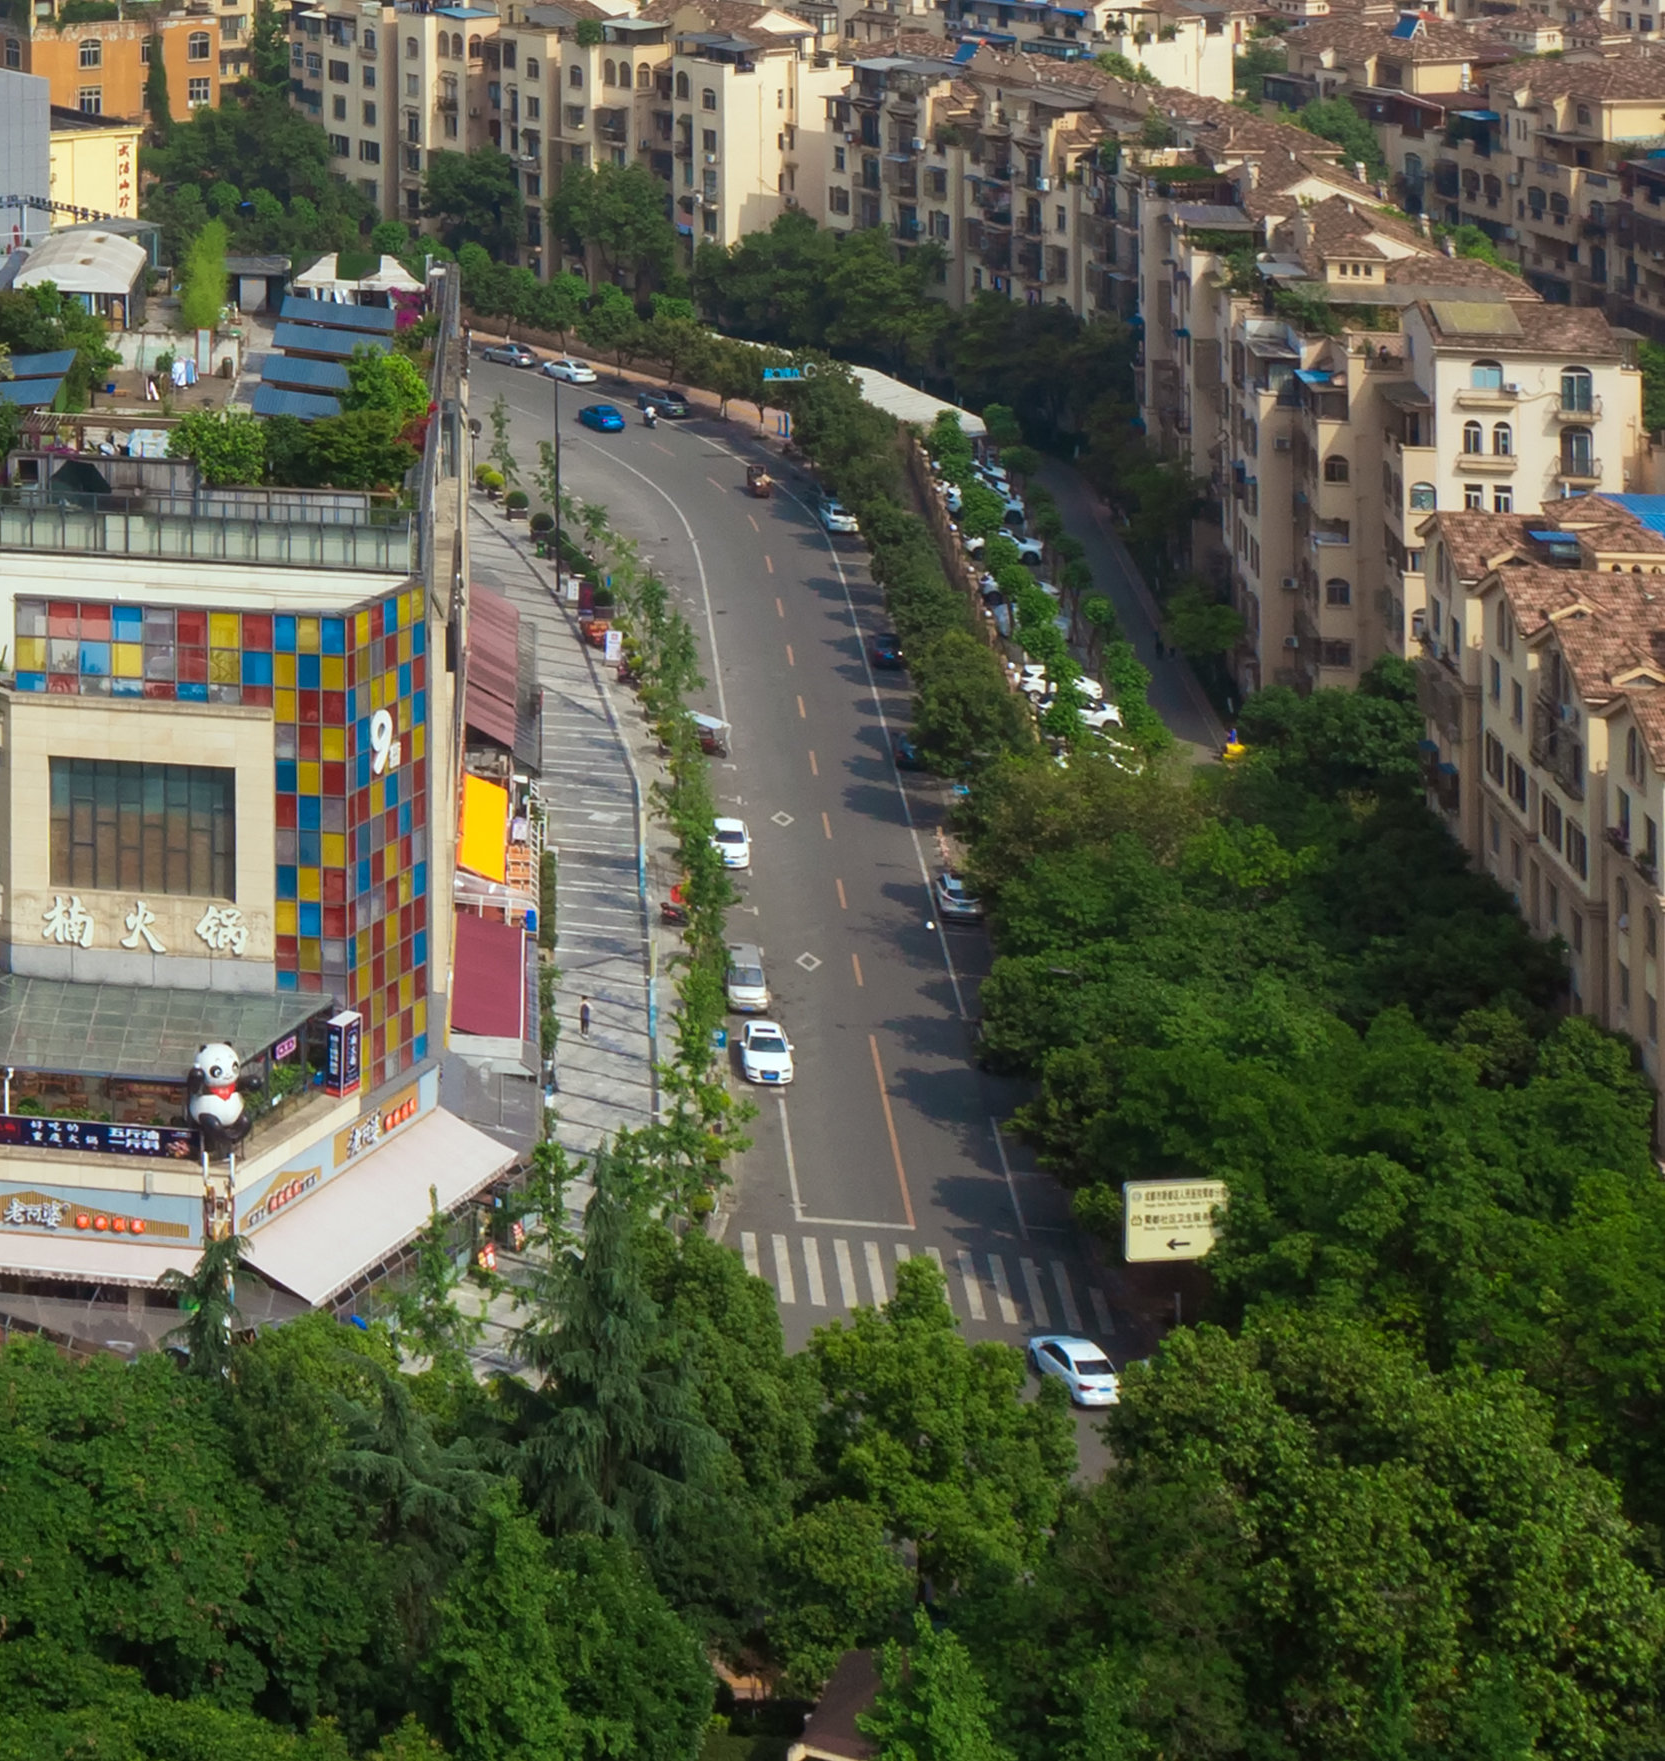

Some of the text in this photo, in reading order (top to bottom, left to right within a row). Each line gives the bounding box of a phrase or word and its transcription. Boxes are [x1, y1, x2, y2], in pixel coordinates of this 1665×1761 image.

[43, 895, 249, 956] 楠火锅
[30, 1120, 79, 1133] 好吃的
[31, 1131, 99, 1146] 重庆火锅
[4, 1198, 63, 1229] 老阿婆
